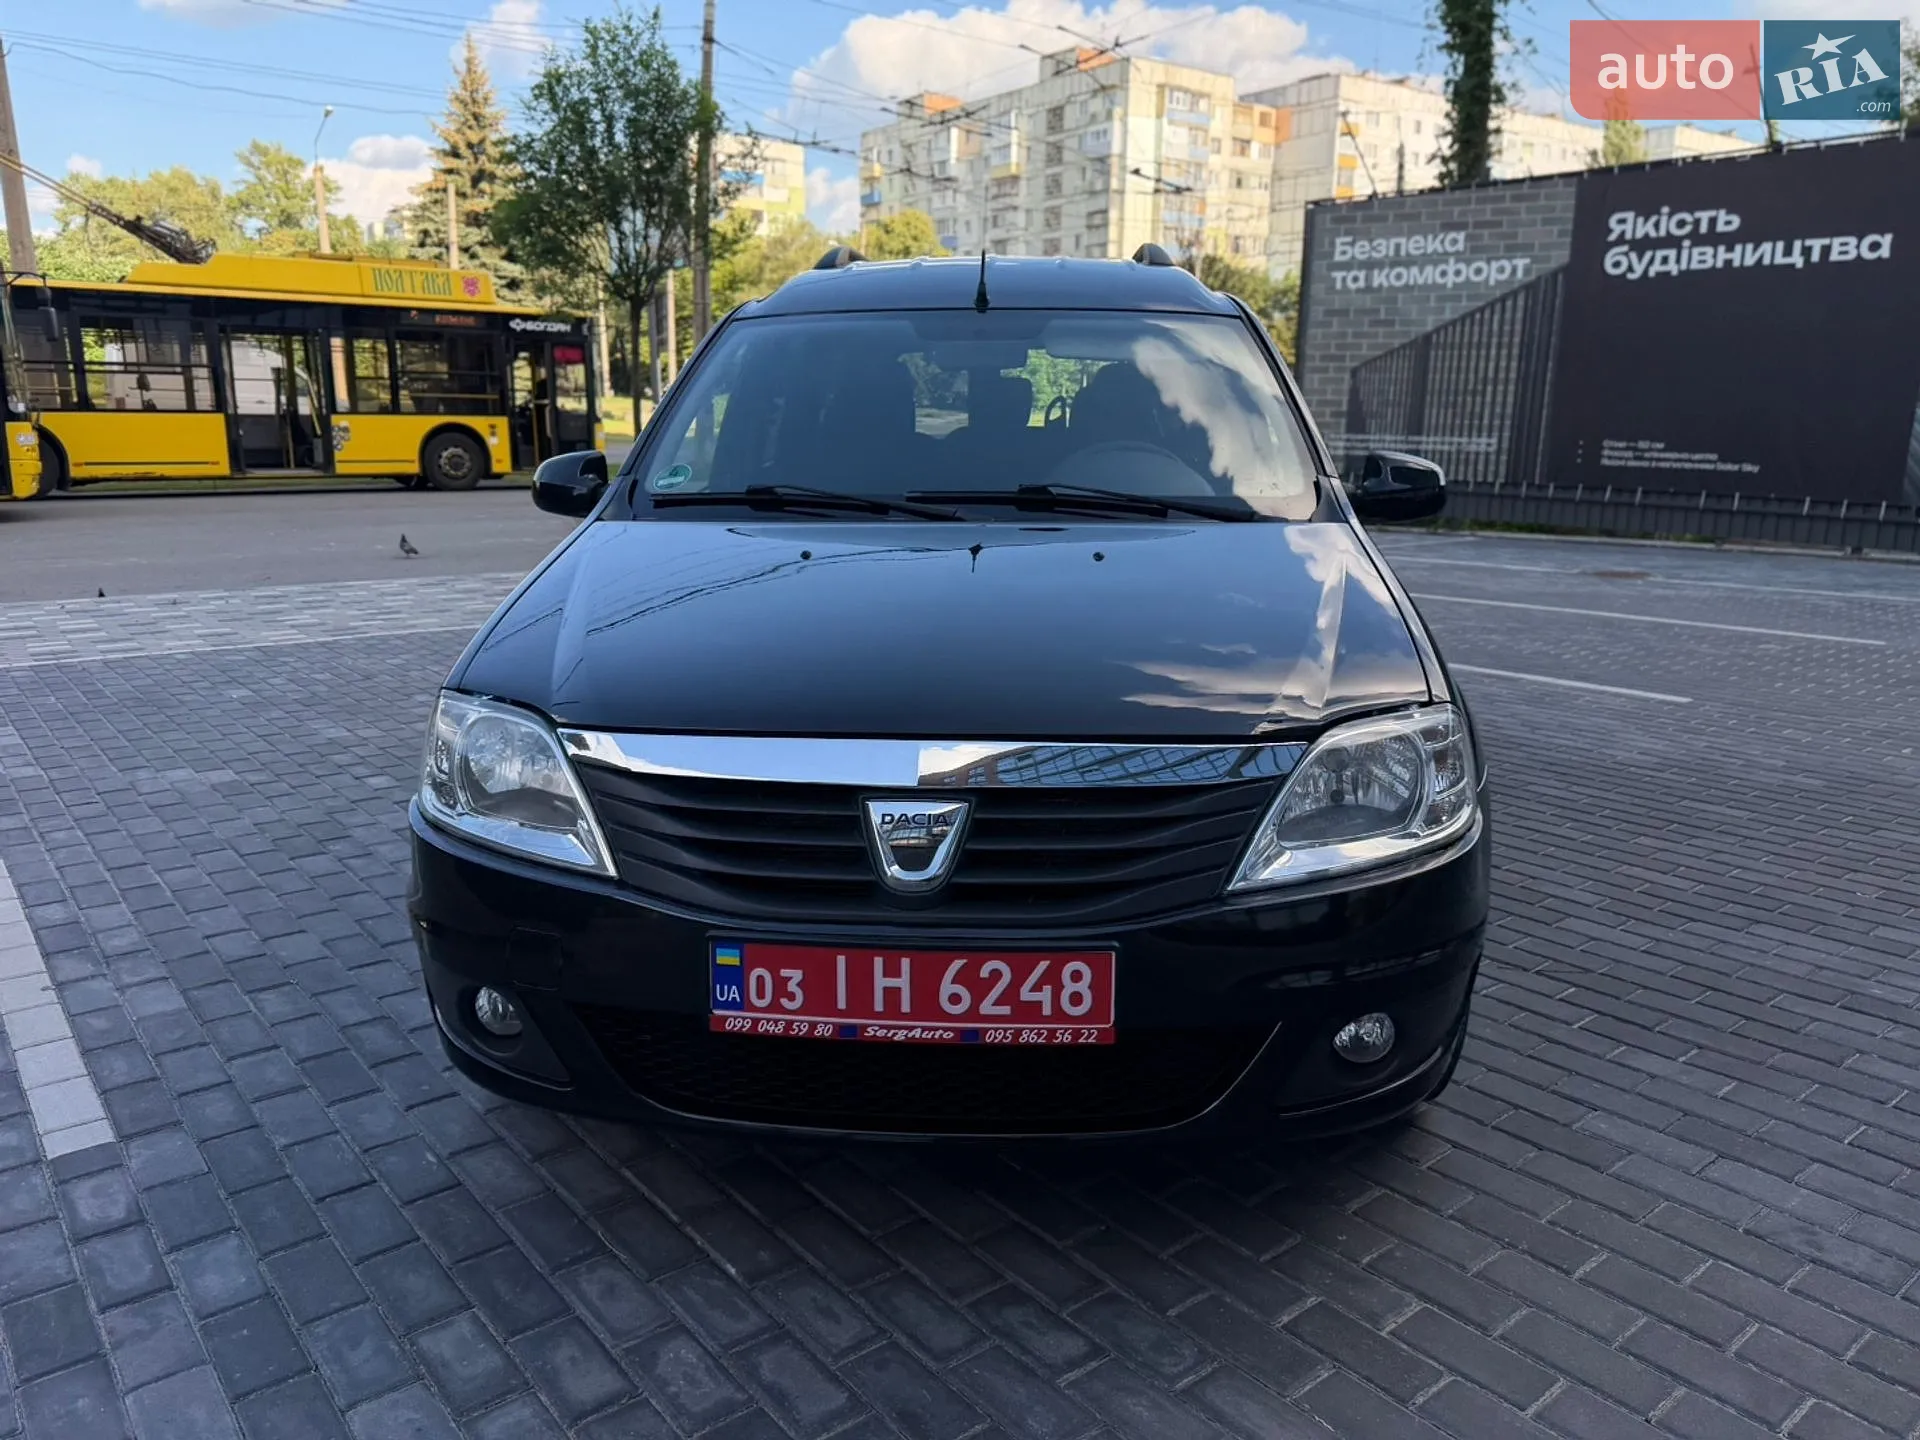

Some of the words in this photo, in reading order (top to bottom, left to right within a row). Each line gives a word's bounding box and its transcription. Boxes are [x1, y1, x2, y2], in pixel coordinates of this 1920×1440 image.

[1606, 206, 1741, 242] Якість
[1333, 231, 1466, 262] Безпека
[1603, 233, 1894, 281] будівництва
[1331, 270, 1365, 290] та
[1372, 256, 1531, 289] комфорт
[881, 813, 948, 826] DACIA
[716, 984, 741, 1003] UA
[749, 967, 805, 1010] 03
[938, 959, 1093, 1017] 6248
[725, 1017, 752, 1031] 099
[757, 1020, 786, 1034] 048
[789, 1022, 809, 1036] 59
[814, 1024, 834, 1037] 80
[864, 1025, 954, 1040] SergAuto
[985, 1029, 1014, 1042] 095
[1018, 1029, 1049, 1043] 862
[1052, 1029, 1073, 1043] 56
[1078, 1029, 1098, 1043] 22
